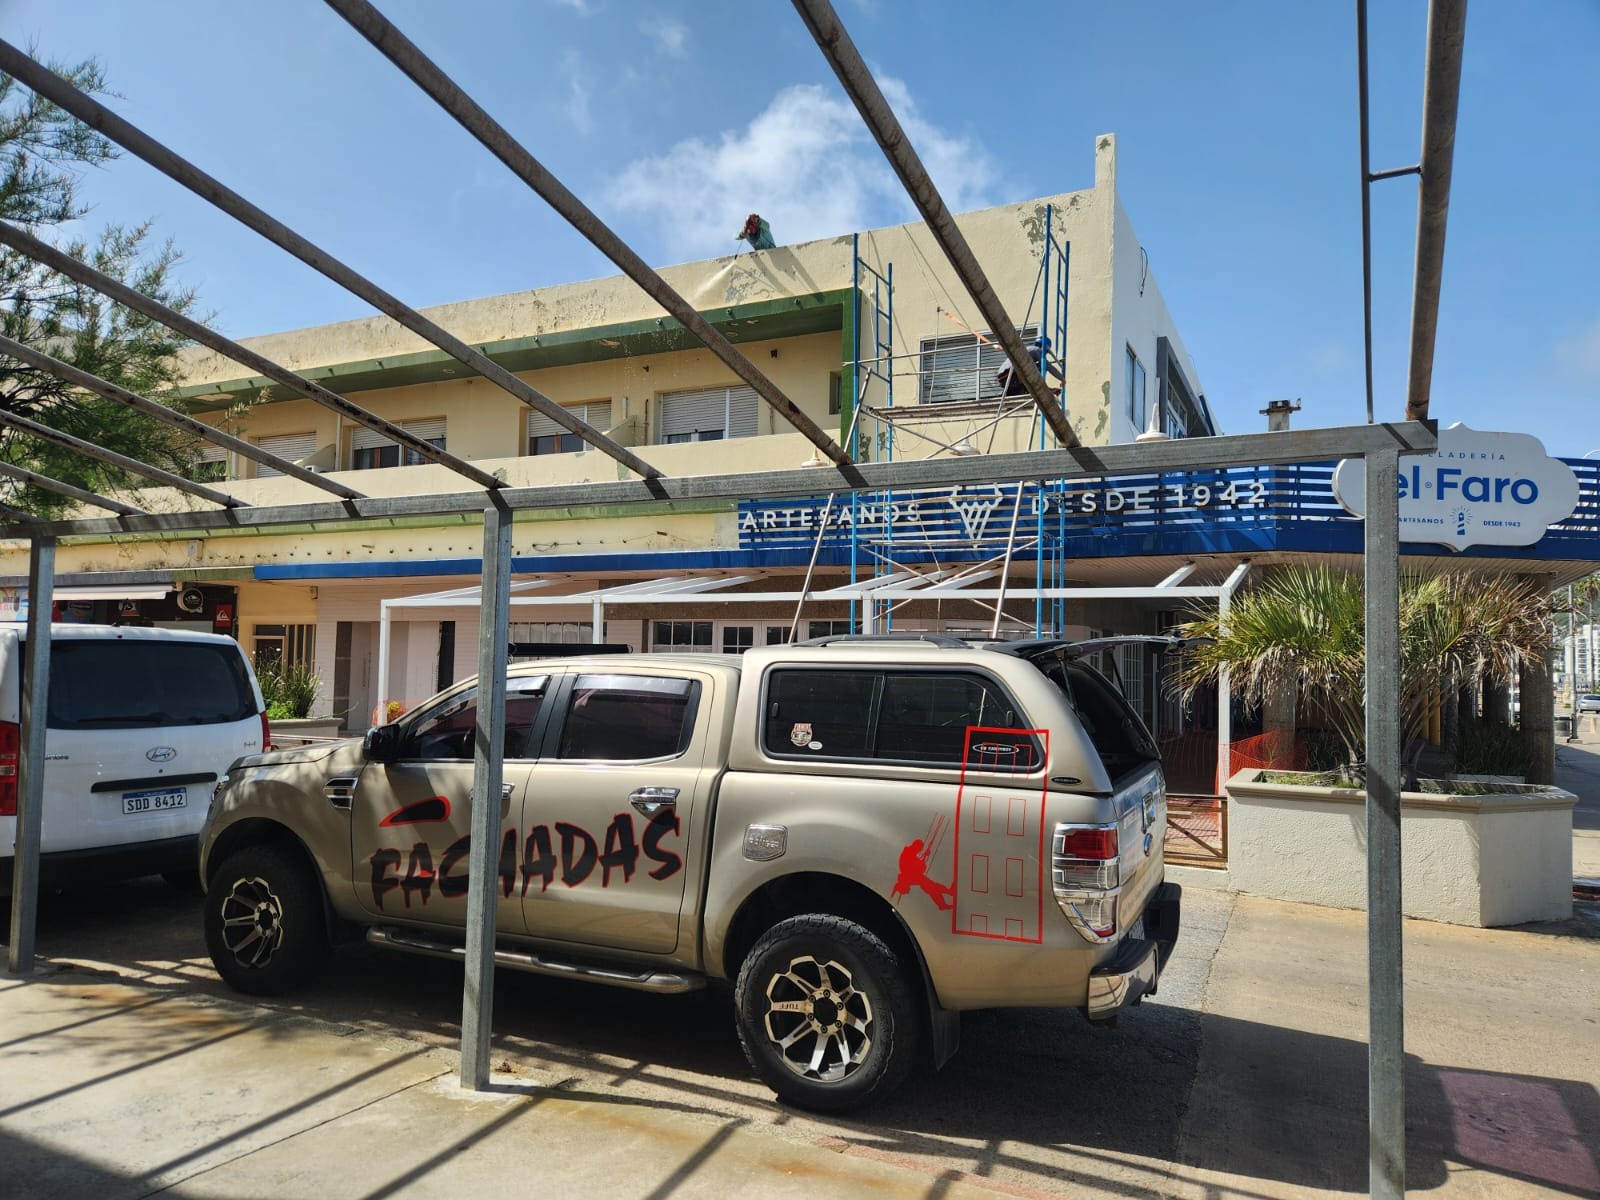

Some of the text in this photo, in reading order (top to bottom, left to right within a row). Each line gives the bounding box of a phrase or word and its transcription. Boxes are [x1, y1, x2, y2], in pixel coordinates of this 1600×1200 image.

[1436, 467, 1539, 505] Faro
[743, 482, 1265, 529] ARTESANOS DESDE 1942
[127, 798, 150, 812] SDD
[155, 794, 184, 808] 8412
